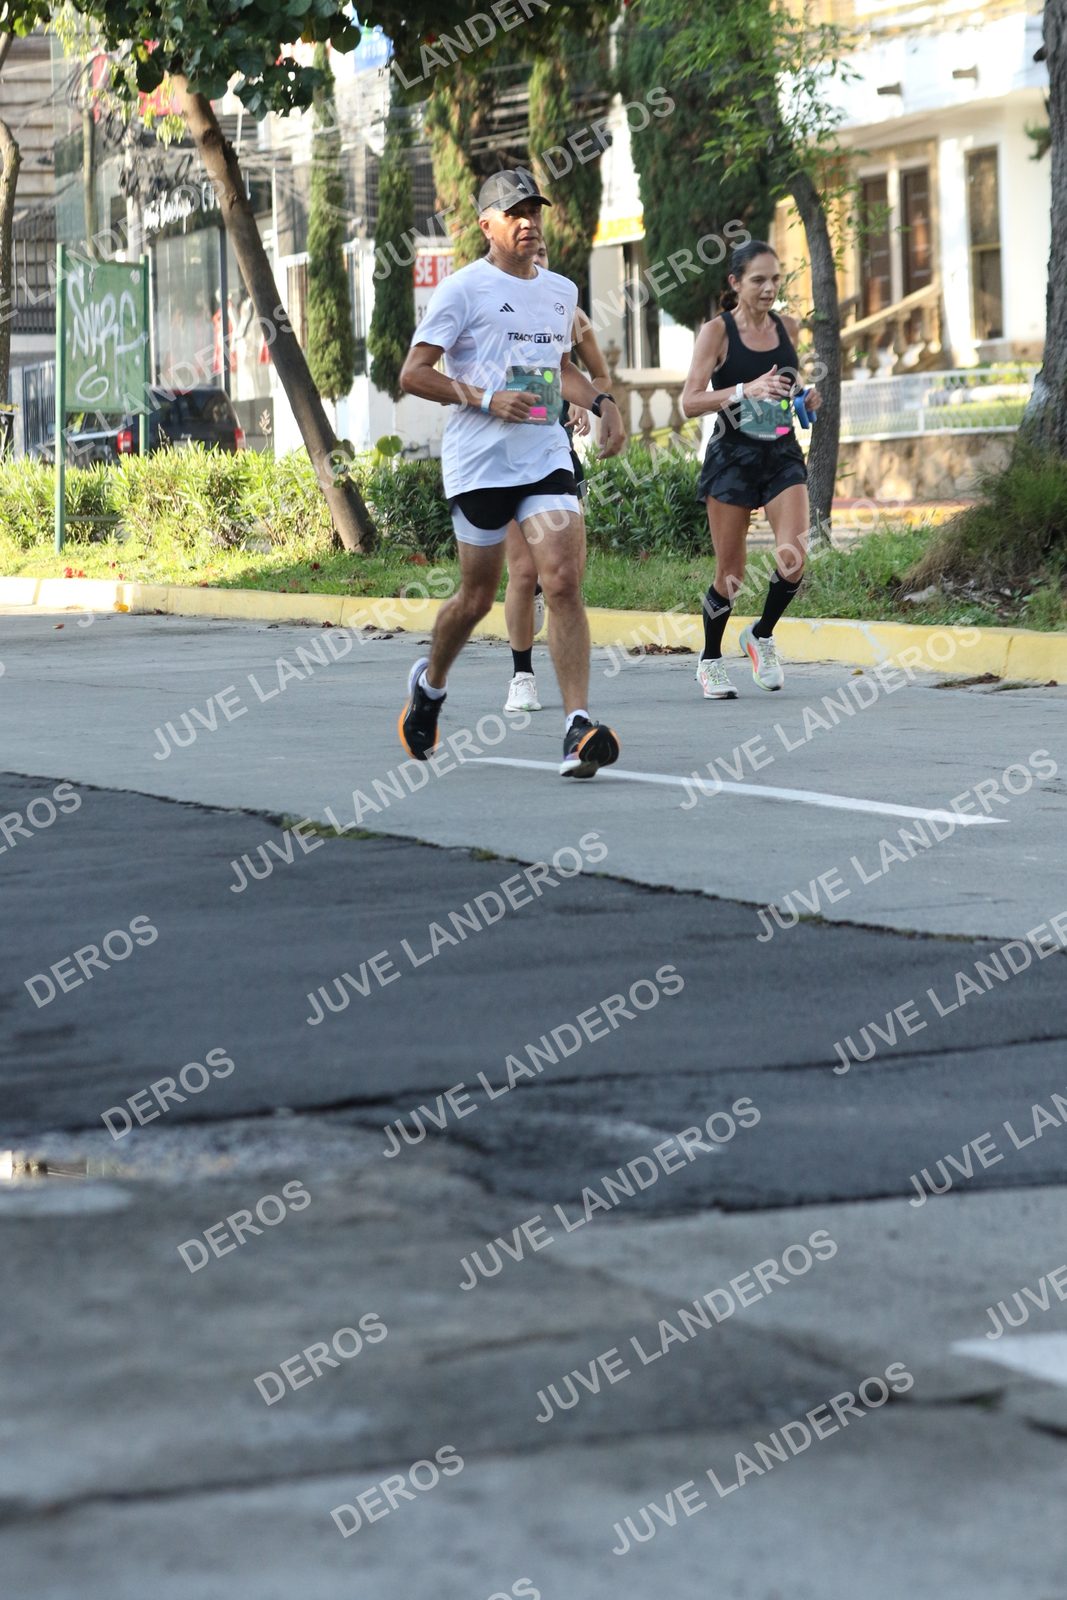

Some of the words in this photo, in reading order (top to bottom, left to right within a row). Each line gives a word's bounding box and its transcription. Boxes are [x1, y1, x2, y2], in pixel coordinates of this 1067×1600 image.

[416, 255, 433, 284] SE
[508, 332, 533, 342] TRACK
[535, 334, 551, 343] FIT
